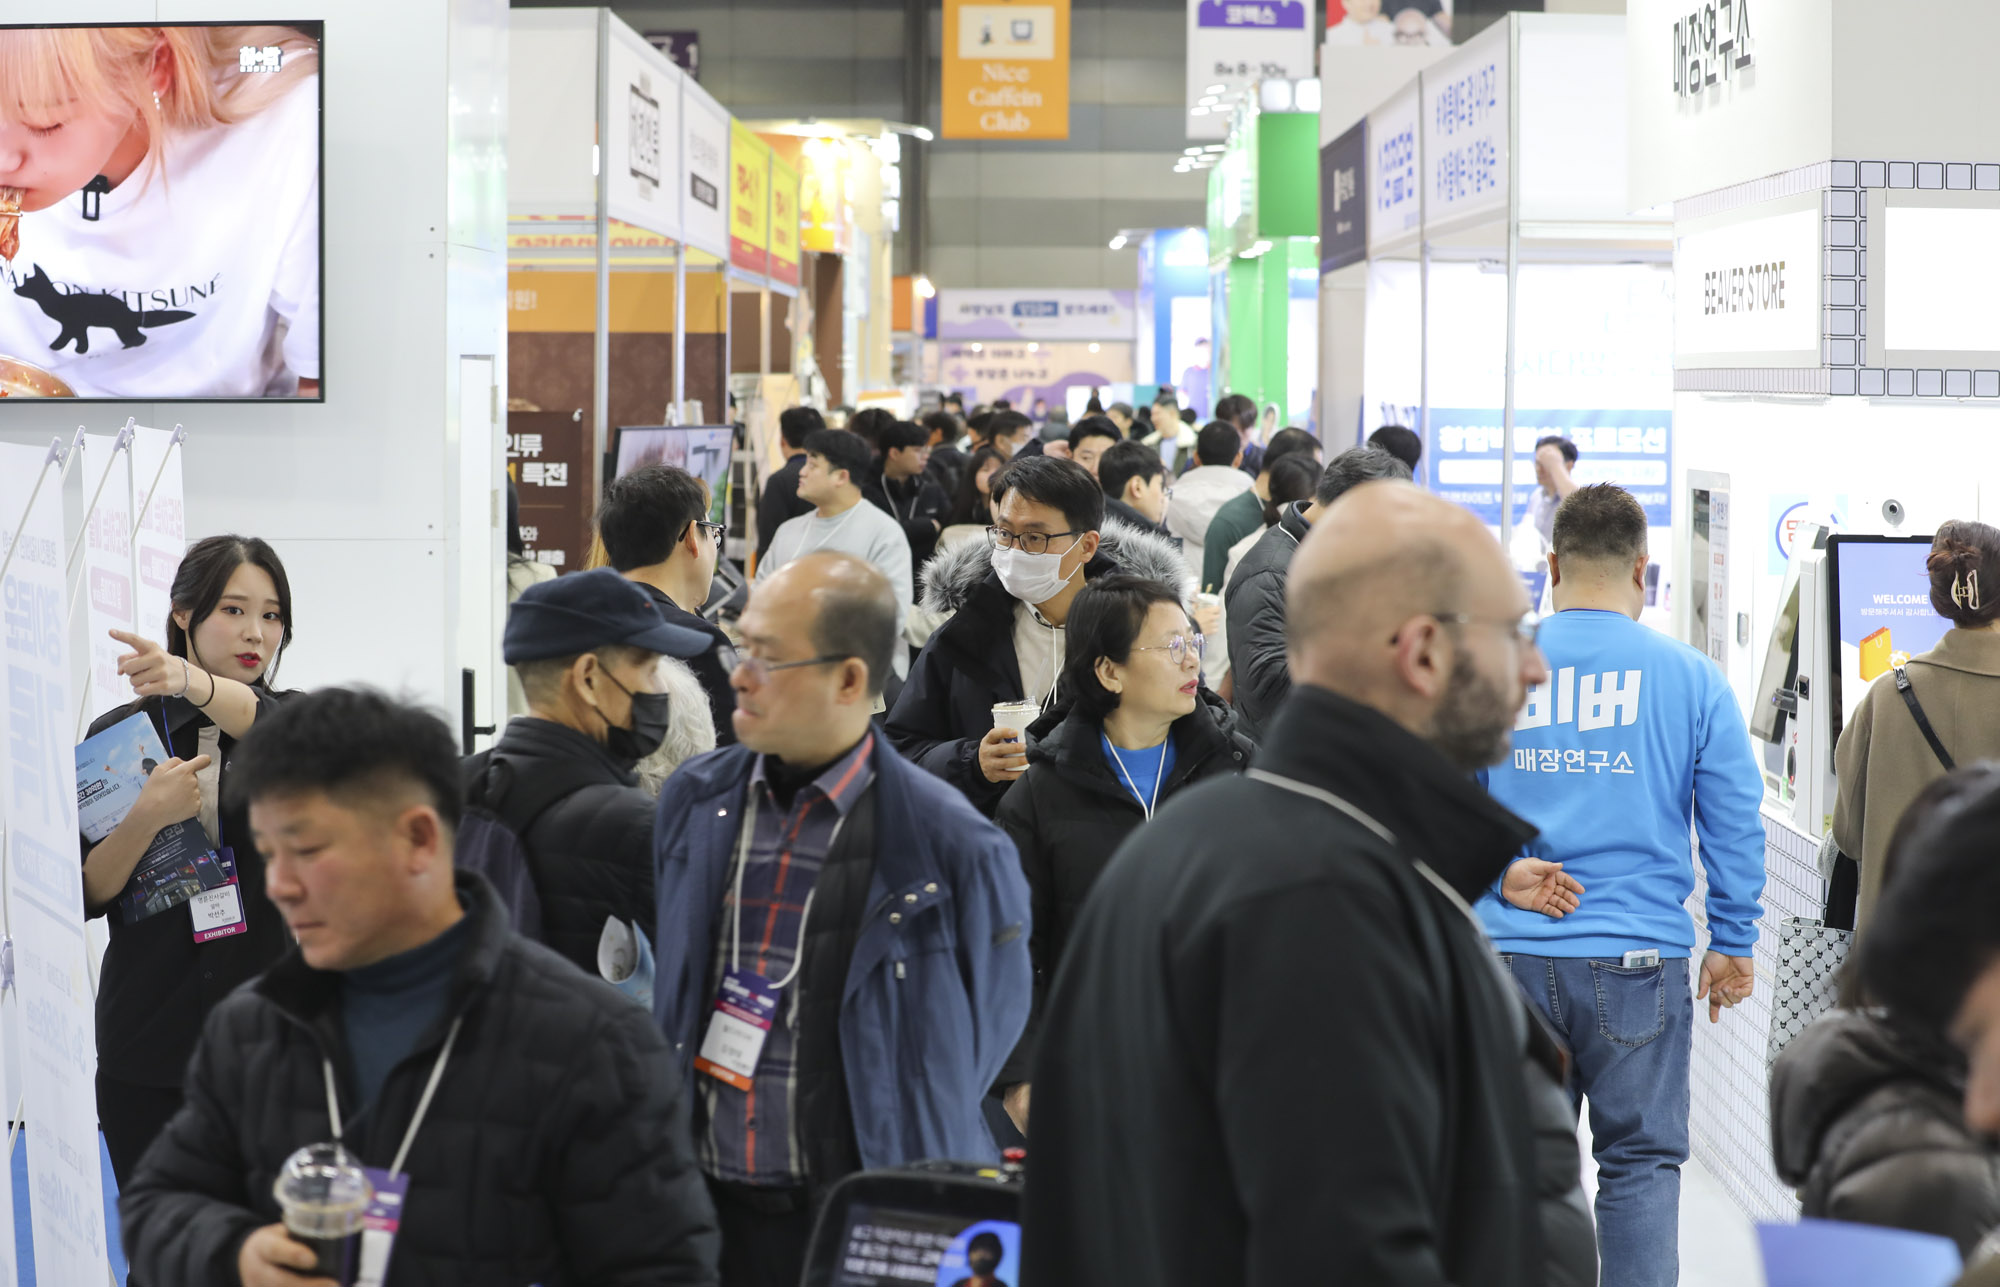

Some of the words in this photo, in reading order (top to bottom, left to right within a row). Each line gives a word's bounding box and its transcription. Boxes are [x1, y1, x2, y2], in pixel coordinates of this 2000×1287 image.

[1673, 0, 1751, 97] 매장연구소
[981, 63, 1030, 83] Nice
[979, 110, 1031, 132] Club
[1704, 265, 1745, 316] BEAVER
[1747, 260, 1786, 312] STORE
[522, 462, 568, 487] 특전
[1873, 594, 1928, 604] WELCOME
[1861, 608, 1903, 616] 방문해주셔서
[1514, 667, 1642, 732] 비버
[1514, 748, 1635, 774] 매장연구소
[204, 926, 236, 940] EXHIBITOR
